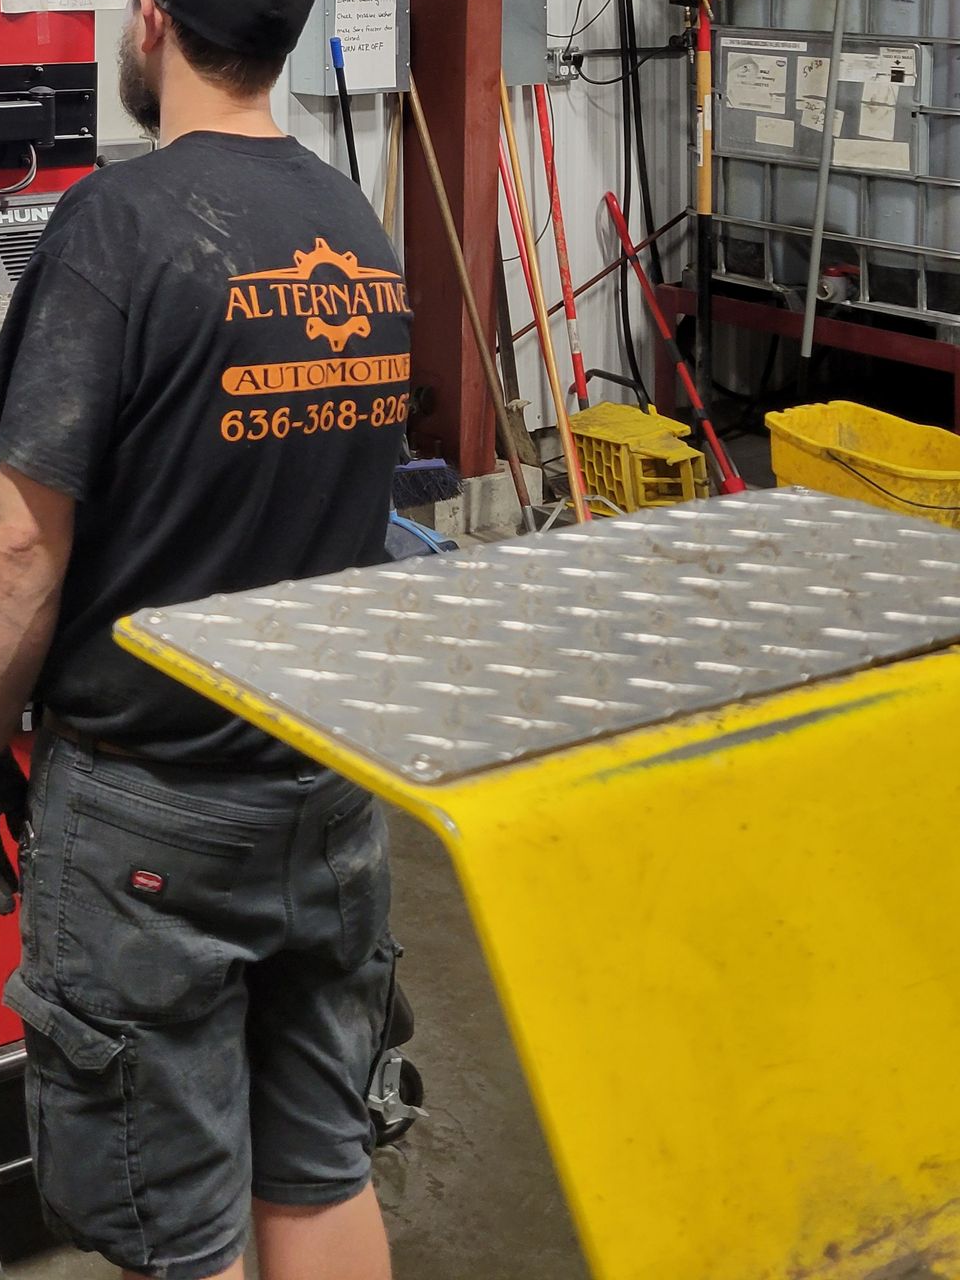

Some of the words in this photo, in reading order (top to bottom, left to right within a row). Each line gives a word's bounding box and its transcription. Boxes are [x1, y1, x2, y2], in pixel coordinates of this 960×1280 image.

[358, 43, 370, 51] AIR
[371, 42, 384, 50] OFF
[225, 282, 411, 321] ALTERNATIVE
[234, 356, 410, 391] AUTOMOTIVE
[220, 394, 410, 442] 636-368-826
